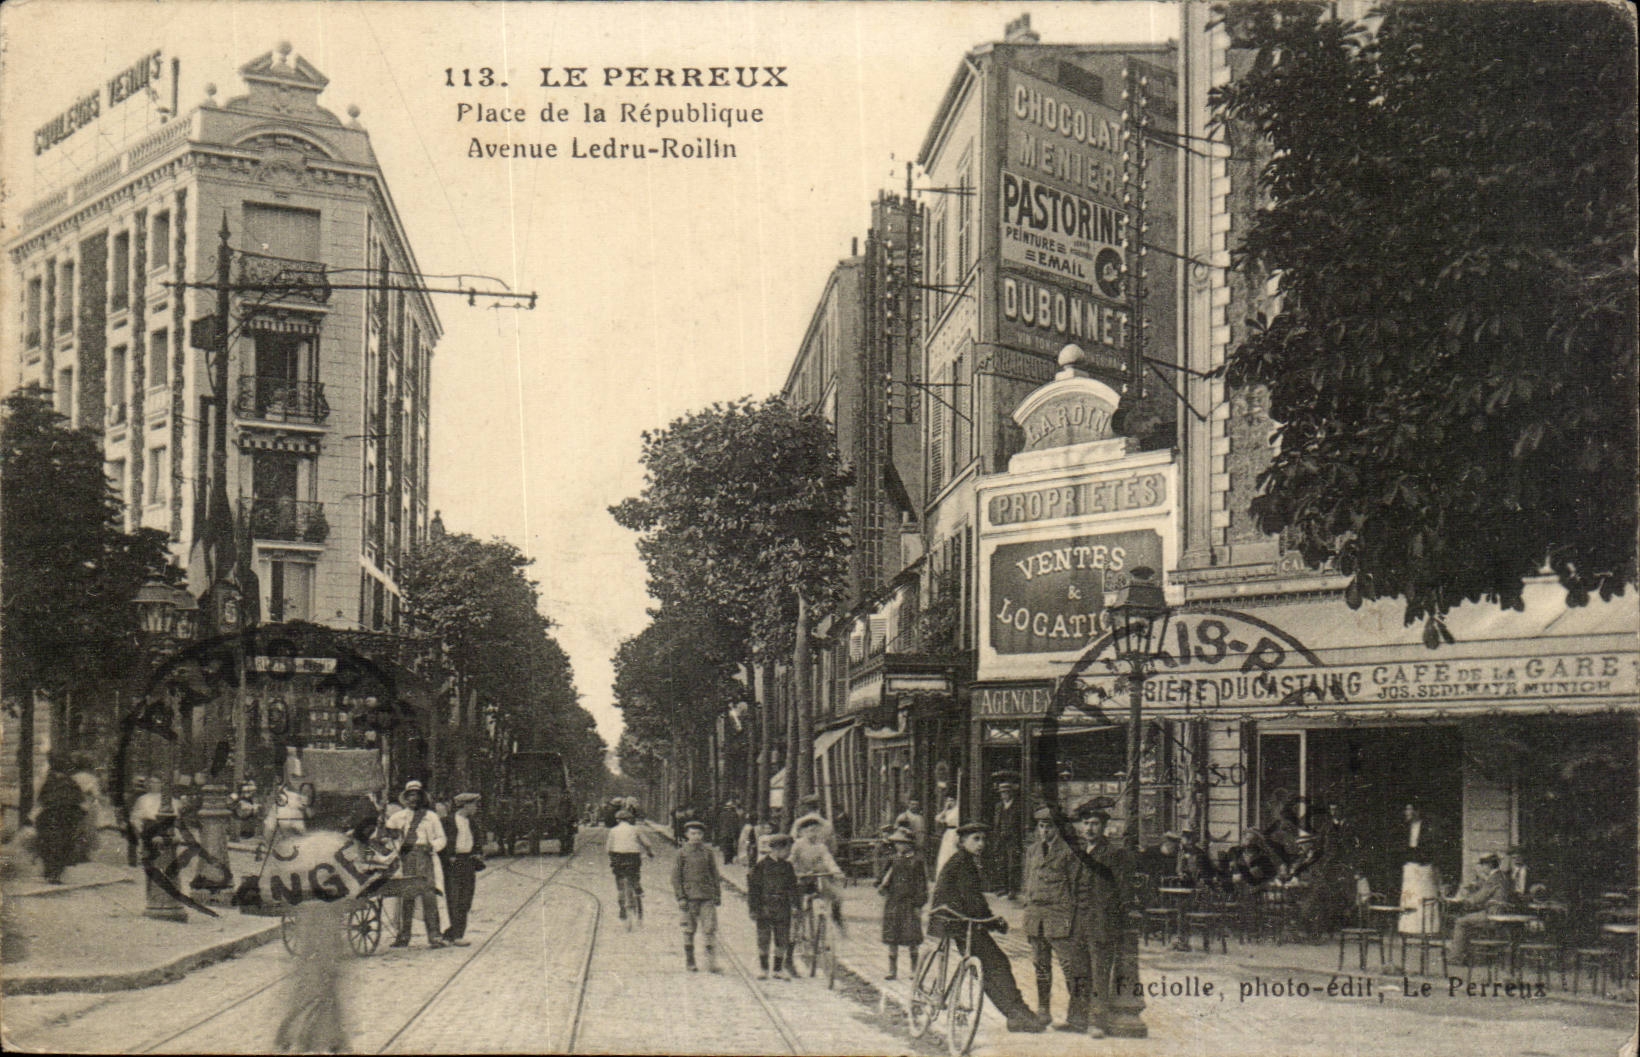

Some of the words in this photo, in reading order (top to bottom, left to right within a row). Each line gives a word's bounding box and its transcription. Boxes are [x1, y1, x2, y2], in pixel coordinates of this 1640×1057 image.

[1014, 83, 1122, 154] CHOCOLAT
[1019, 131, 1118, 198] MENIER
[1003, 173, 1126, 248] PASTORINE
[1006, 226, 1056, 252] PEINTURE
[1004, 278, 1127, 349] DUBONNET
[1015, 545, 1127, 580] VENTES
[1068, 585, 1082, 600] &
[1458, 668, 1482, 682] DE
[1493, 667, 1516, 680] LA
[1525, 656, 1619, 679] GARE
